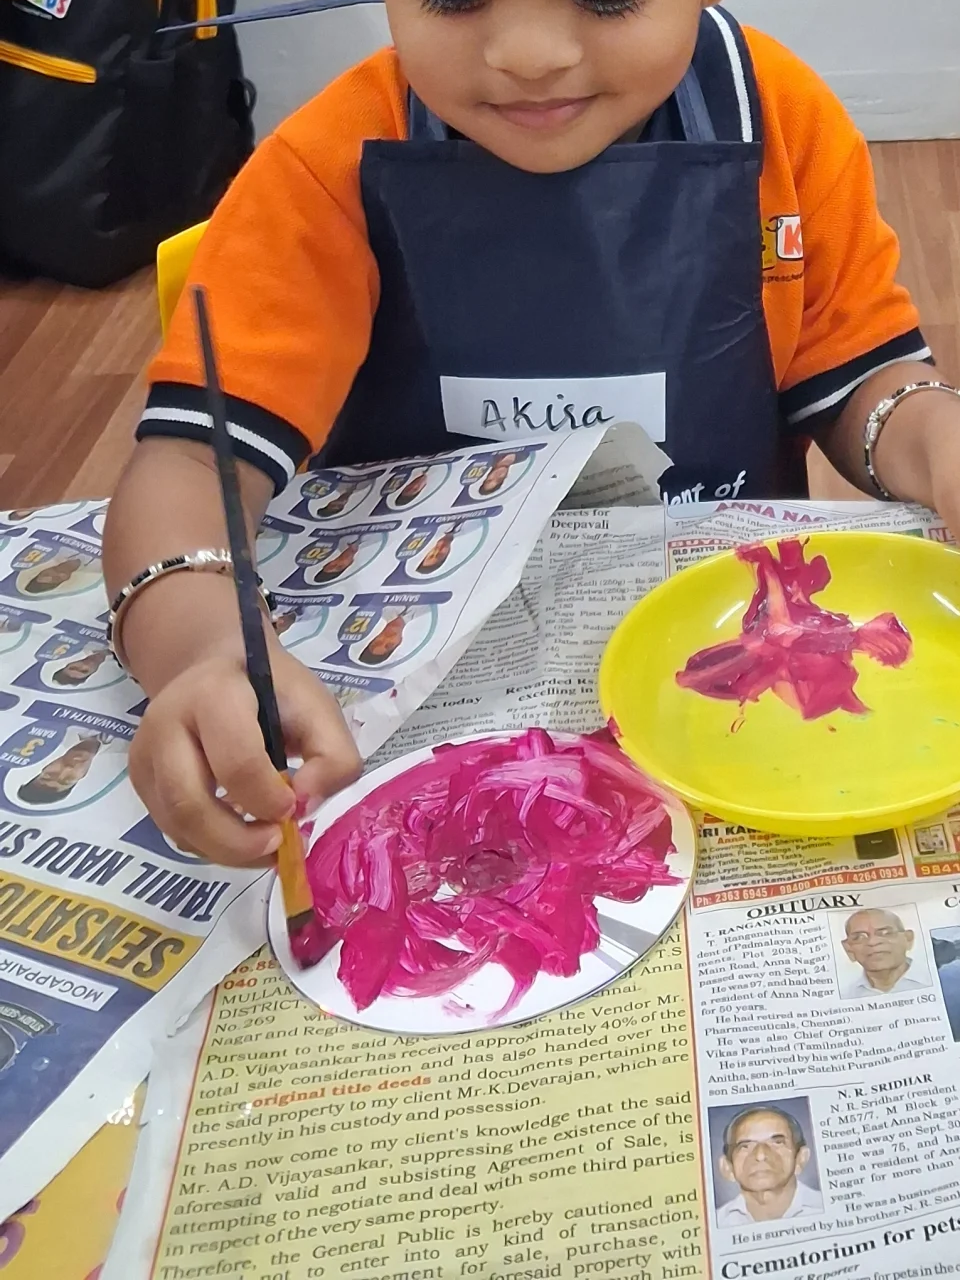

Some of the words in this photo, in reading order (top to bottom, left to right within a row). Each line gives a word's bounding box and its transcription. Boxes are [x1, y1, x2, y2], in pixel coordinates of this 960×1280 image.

[714, 470, 747, 498] of
[551, 520, 609, 531] Deepavali
[592, 508, 610, 517] for
[506, 678, 572, 695] Rewarded
[518, 688, 577, 702] excelling
[580, 685, 594, 694] in
[443, 696, 483, 708] today
[21, 836, 135, 886] NADU
[122, 861, 231, 922] TAMIL
[696, 896, 712, 906] Ph:
[715, 892, 740, 902] 2363
[743, 888, 768, 899] 6945
[746, 894, 862, 920] OBITUARY
[719, 915, 815, 935] RANGANATHAN
[252, 1088, 326, 1108] original
[332, 1083, 372, 1096] title
[377, 1076, 431, 1091] deeds
[838, 1089, 852, 1099] N.
[855, 1087, 868, 1097] R.
[870, 1073, 933, 1095] SRIDHAR
[183, 1165, 197, 1176] It
[204, 1162, 238, 1175] has
[245, 1156, 284, 1170] now
[290, 1147, 339, 1163] come
[346, 1143, 363, 1155] to
[370, 1138, 399, 1152] my
[405, 1127, 469, 1147] client's
[477, 1111, 570, 1137] knowledge
[577, 1104, 613, 1118] that
[620, 1098, 648, 1110] the
[655, 1091, 692, 1106] said
[721, 1234, 876, 1280] Crematorium
[883, 1226, 915, 1247] for
